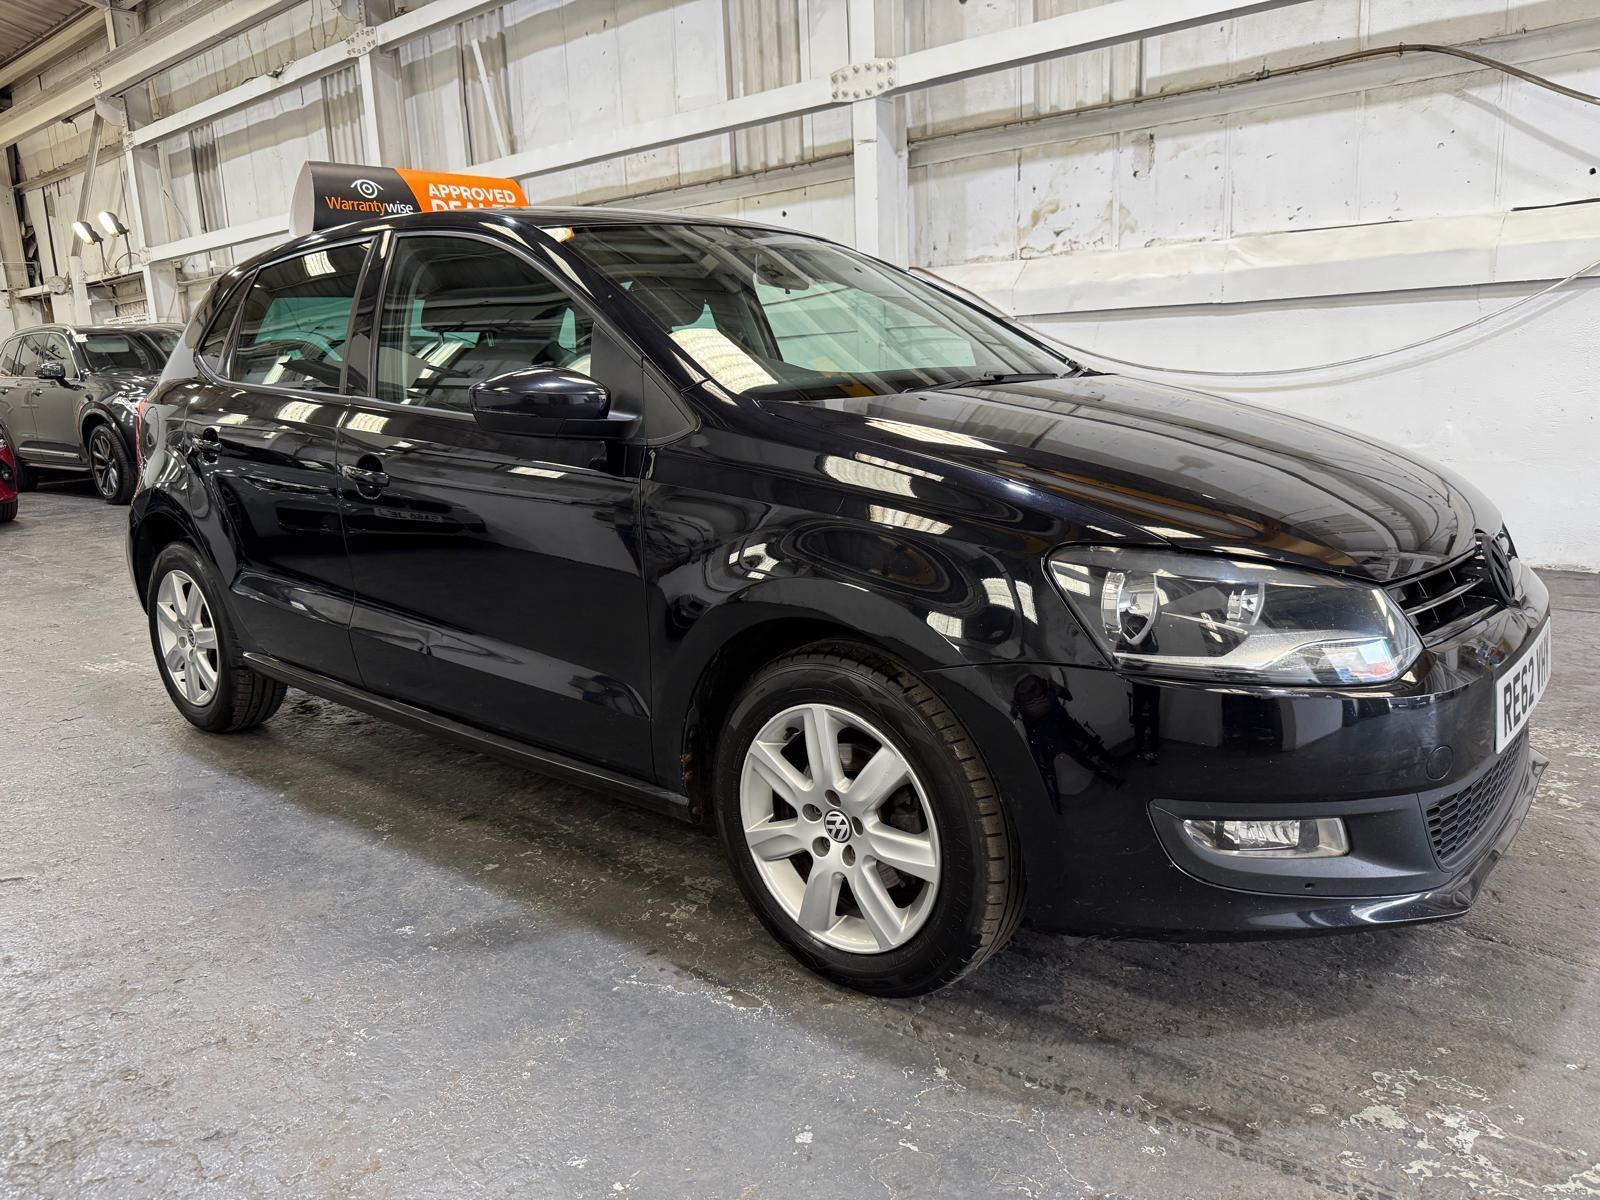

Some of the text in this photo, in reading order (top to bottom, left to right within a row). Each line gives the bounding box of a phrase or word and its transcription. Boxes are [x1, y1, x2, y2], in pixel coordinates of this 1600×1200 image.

[428, 183, 516, 204] APPROVED
[325, 196, 413, 215] Warrantywise
[1503, 656, 1534, 738] RE62
